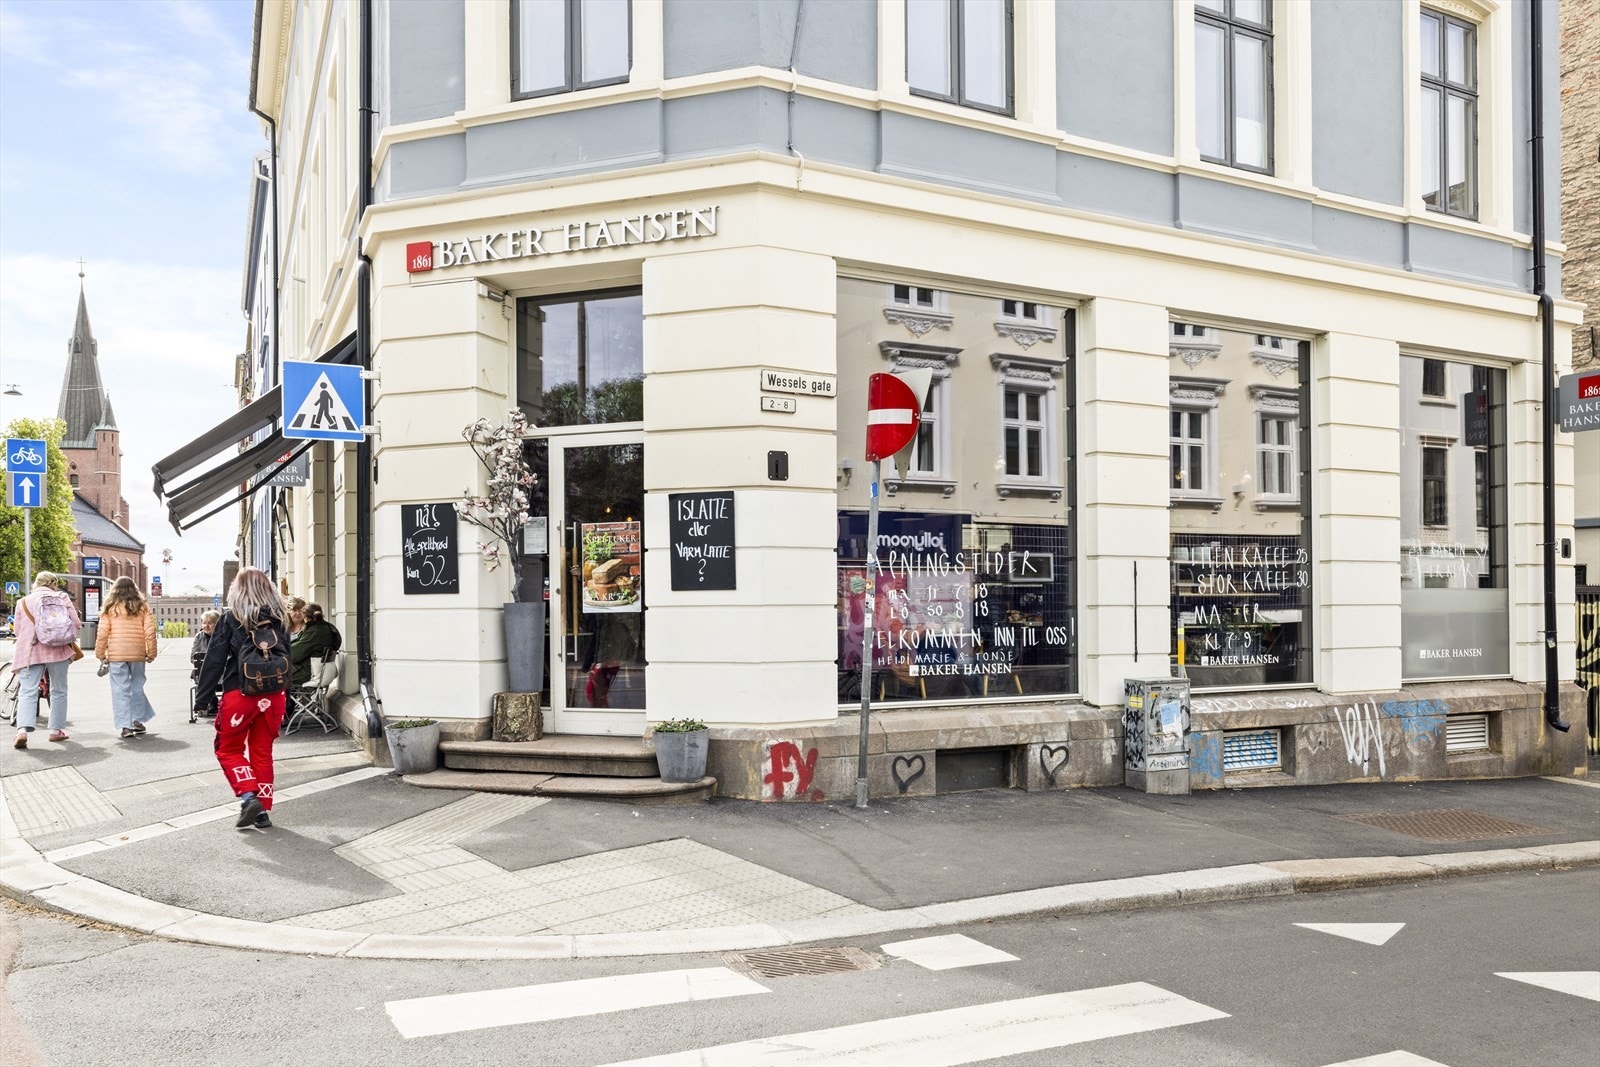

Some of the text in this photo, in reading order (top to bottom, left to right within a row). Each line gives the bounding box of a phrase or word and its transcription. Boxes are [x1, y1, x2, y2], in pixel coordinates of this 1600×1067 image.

[412, 205, 719, 269] 1861 BAKER HANSEN
[767, 373, 831, 393] Wessels gate
[266, 465, 298, 474] BAER
[678, 498, 732, 521] ISLATTE
[688, 522, 711, 536] eller
[675, 542, 732, 560] VARM LATTE
[1242, 546, 1290, 569] KAFFE
[698, 558, 707, 582] ?
[974, 582, 988, 599] 18
[1197, 573, 1238, 594] STOR
[1243, 570, 1290, 592] KAFFE
[955, 601, 964, 619] 8
[974, 600, 989, 617] 18
[1194, 603, 1266, 625] MA FR
[1205, 632, 1221, 650] KL
[1243, 631, 1252, 648] 9
[914, 651, 951, 665] MARIE
[1210, 654, 1280, 666] BAKER HANSEN
[1427, 648, 1482, 659] BAKER HANSEN
[921, 663, 1013, 676] BAKER HANSEN
